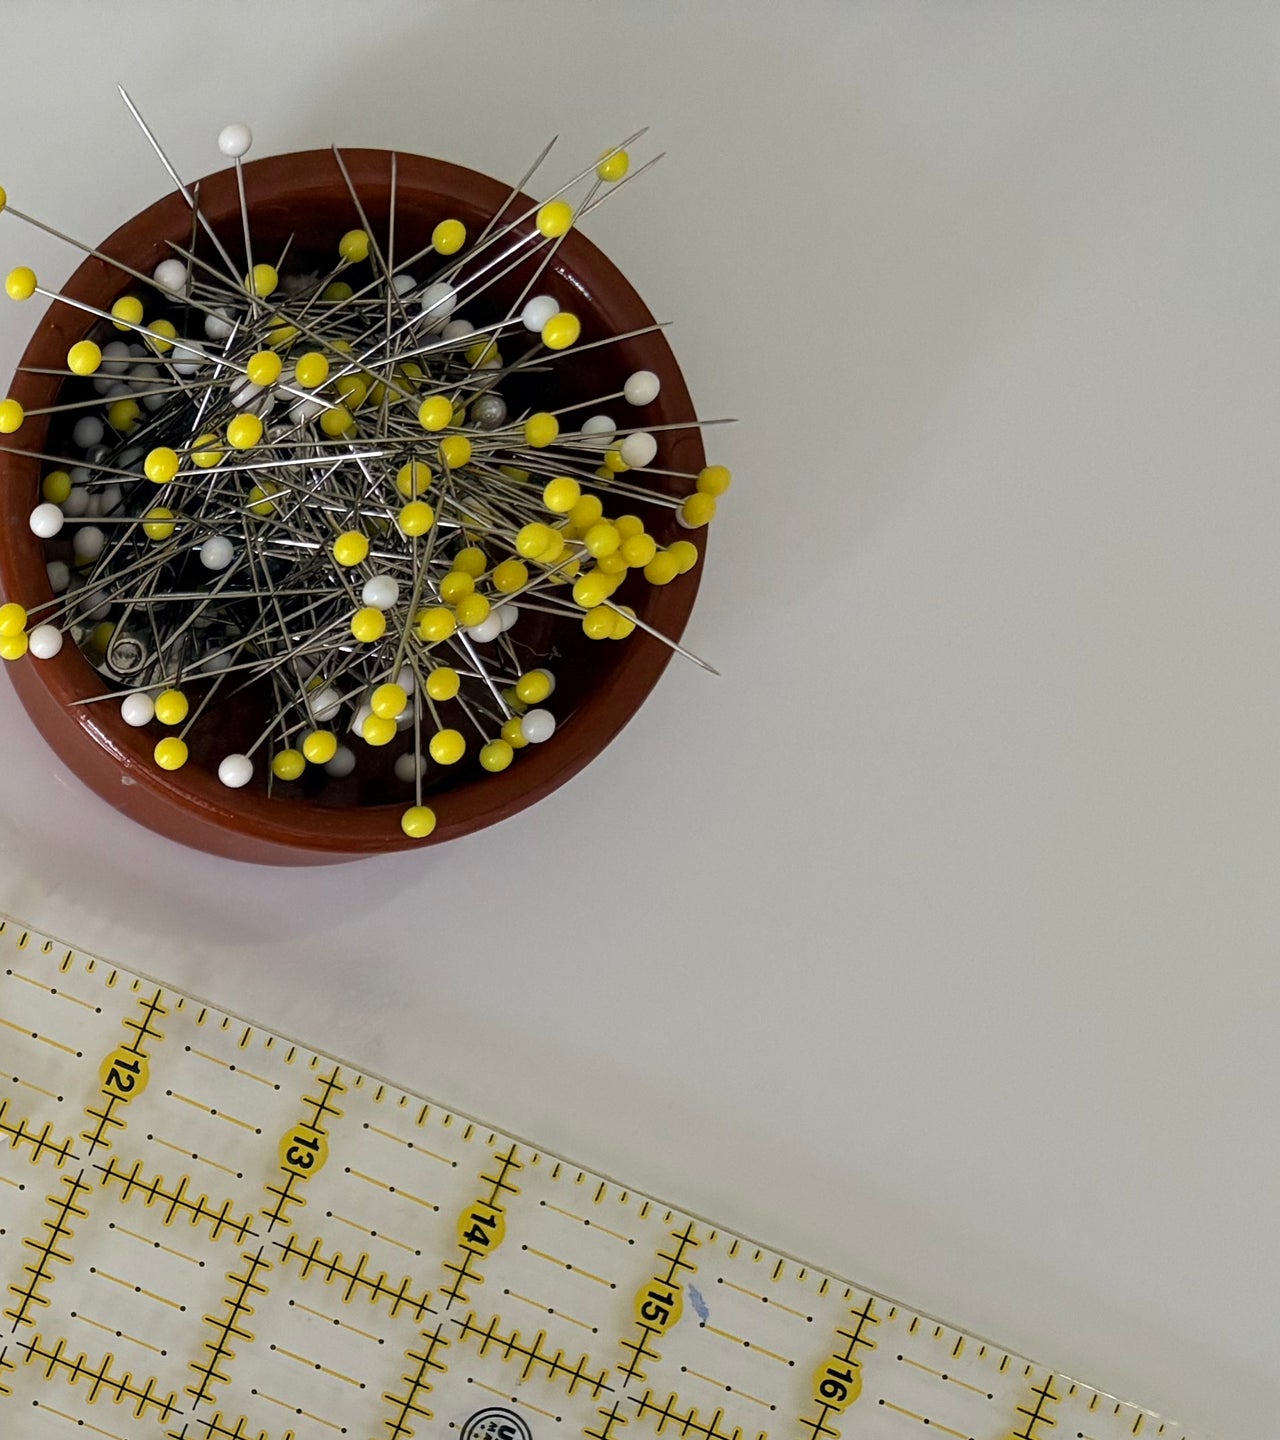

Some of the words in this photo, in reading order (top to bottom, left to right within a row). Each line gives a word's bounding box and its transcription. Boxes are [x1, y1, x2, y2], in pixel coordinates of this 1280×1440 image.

[105, 1058, 141, 1093] 12
[286, 1135, 320, 1170] 13
[462, 1213, 497, 1247] 14
[640, 1290, 675, 1326] 15
[819, 1367, 854, 1402] 16
